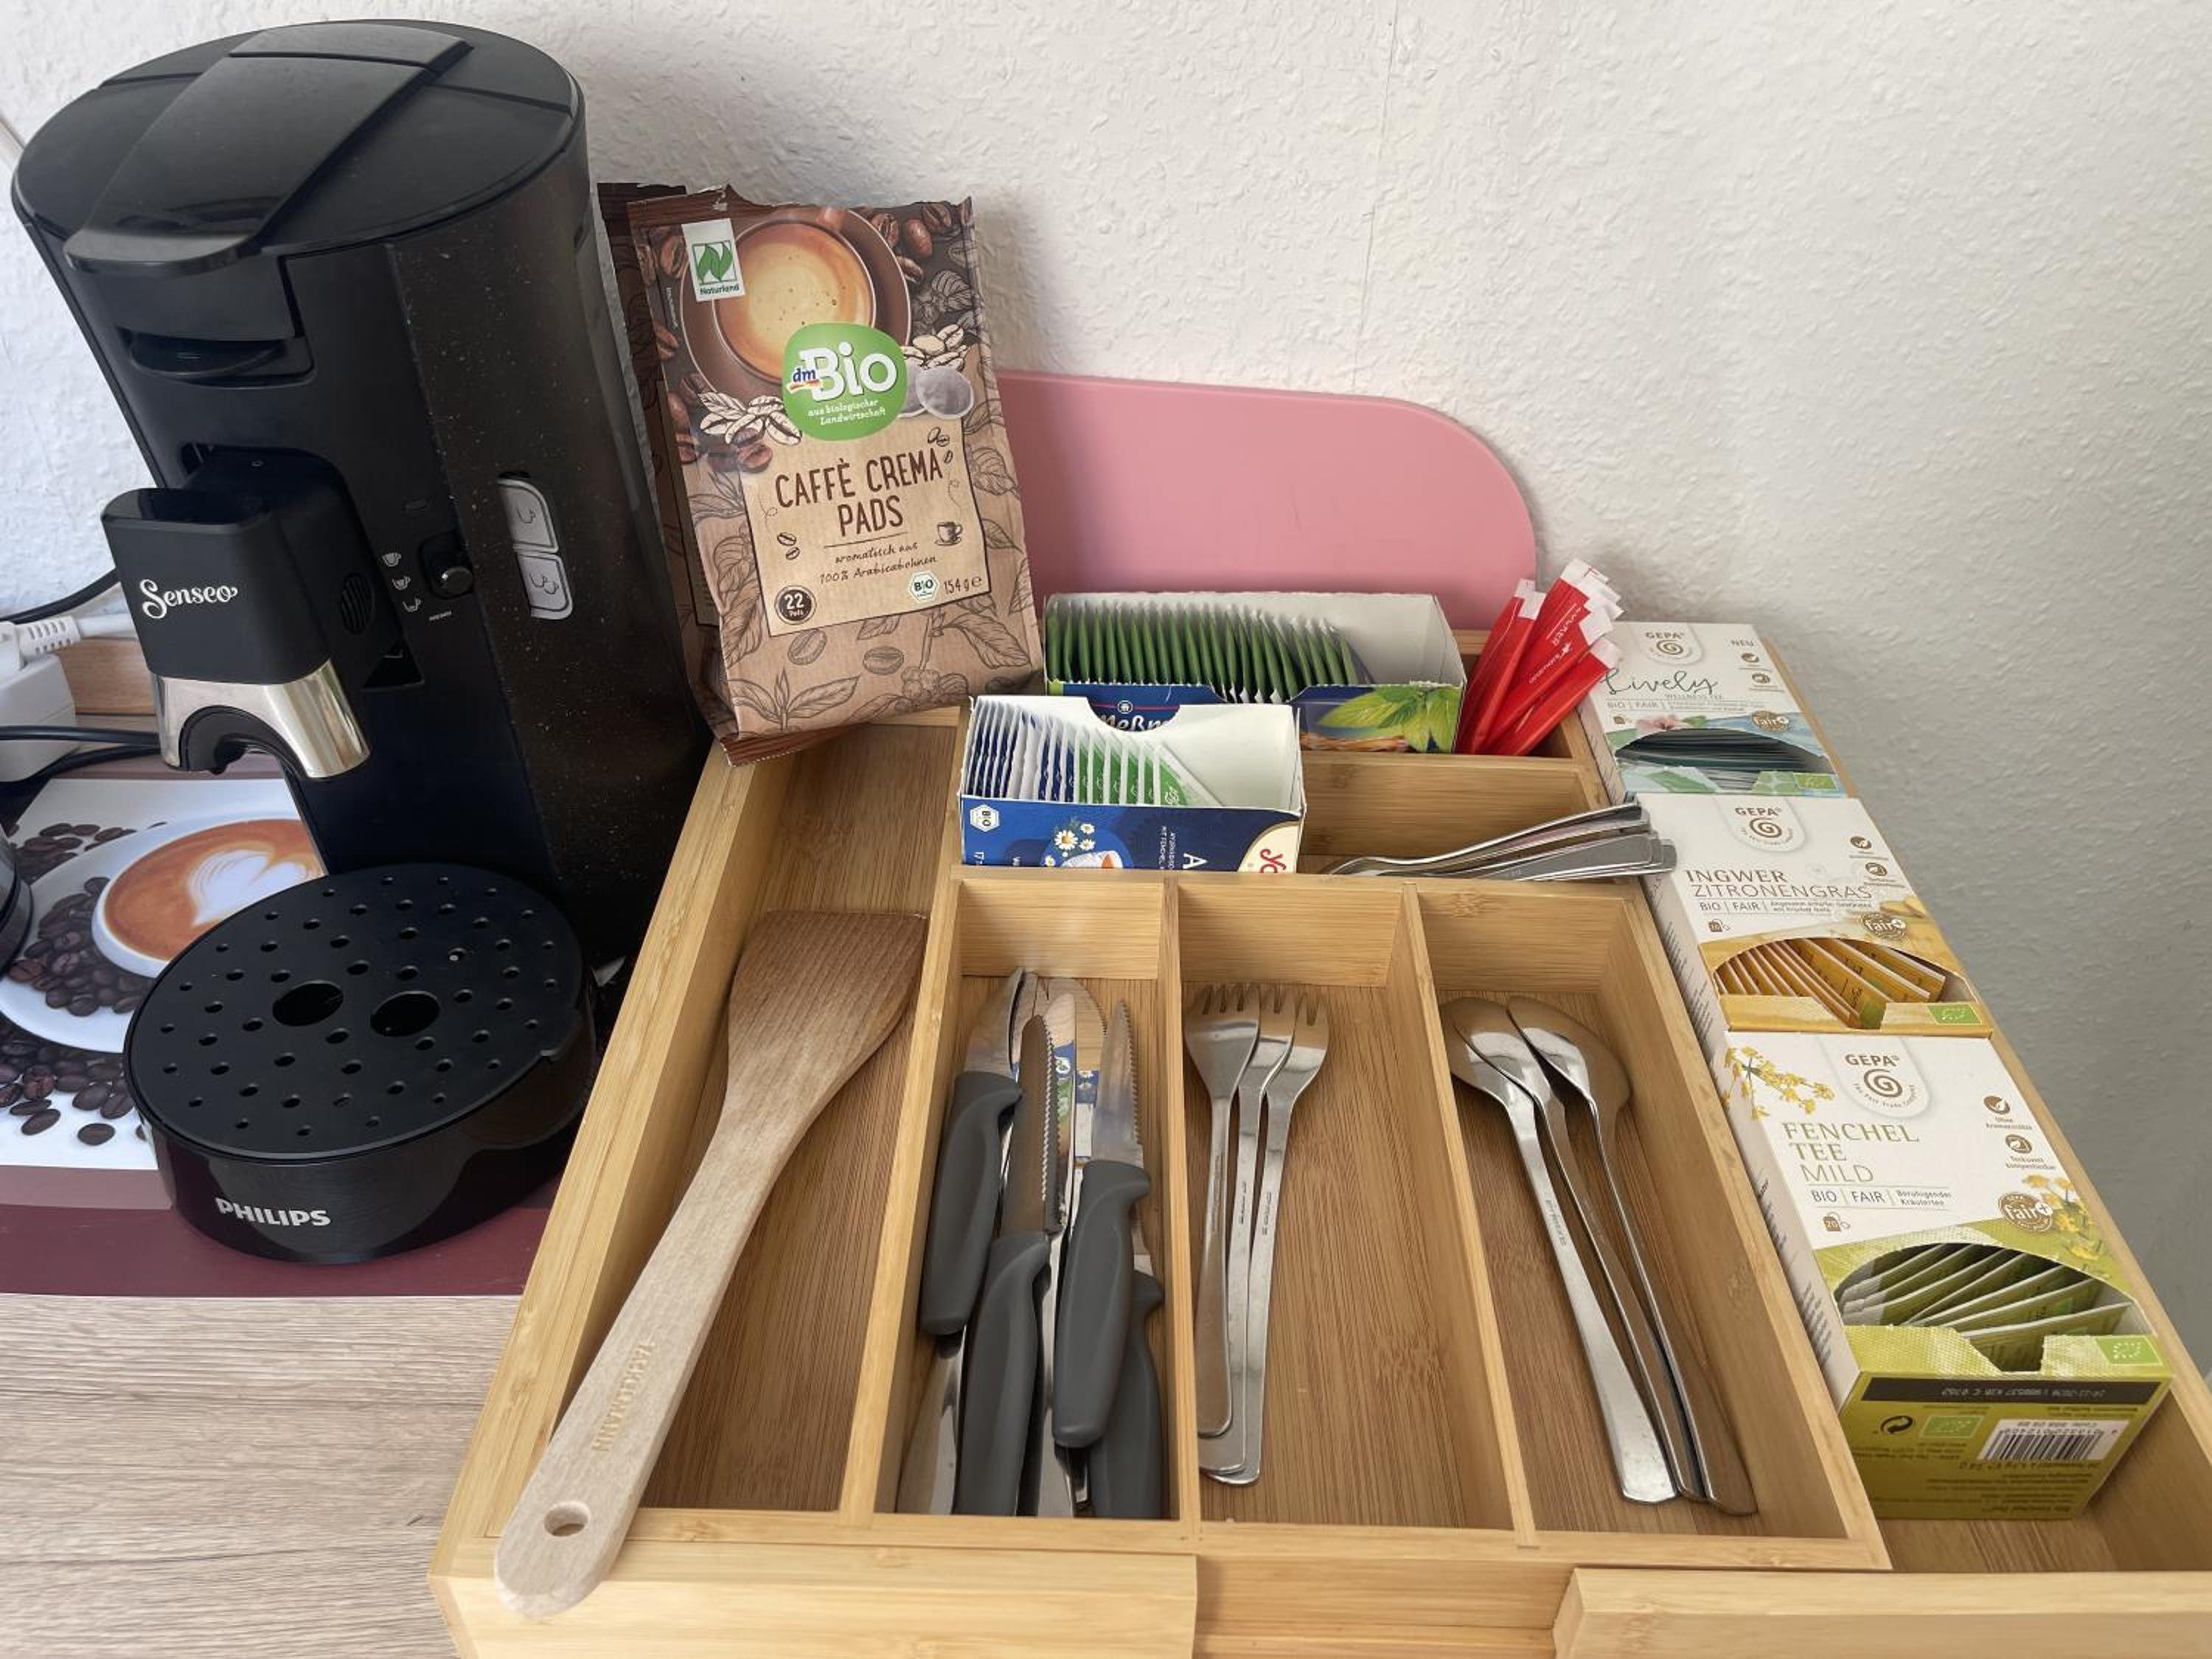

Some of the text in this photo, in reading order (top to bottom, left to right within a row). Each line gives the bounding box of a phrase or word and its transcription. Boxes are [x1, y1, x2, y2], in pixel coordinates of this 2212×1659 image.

[700, 285, 740, 296] Naturland
[793, 341, 898, 402] dm Bio
[807, 399, 879, 417] aus biologischer
[820, 408, 886, 425] Landwirtschaft
[776, 448, 943, 508] CAFFÈ CREMA
[838, 495, 903, 537] PADS
[835, 542, 919, 563] aromatisch aus
[819, 555, 937, 584] 100% Arabicabohnen
[914, 579, 934, 591] BIO
[943, 579, 962, 596] 154
[139, 578, 238, 619] Senseo
[785, 593, 805, 610] 22
[1603, 667, 1719, 695] Lively
[981, 810, 991, 827] BIO
[1686, 869, 1788, 883] INGWER
[1691, 884, 1873, 900] ZITRONENGRAS
[1700, 901, 1722, 911] BIO
[1733, 901, 1761, 911] FAIR
[1782, 1121, 1920, 1142] FENCHEL
[1789, 1142, 1847, 1161] TEE
[1799, 1164, 1874, 1183] MILD
[1810, 1189, 1886, 1204] BIO FAIR
[214, 1196, 331, 1226] PHILIPS
